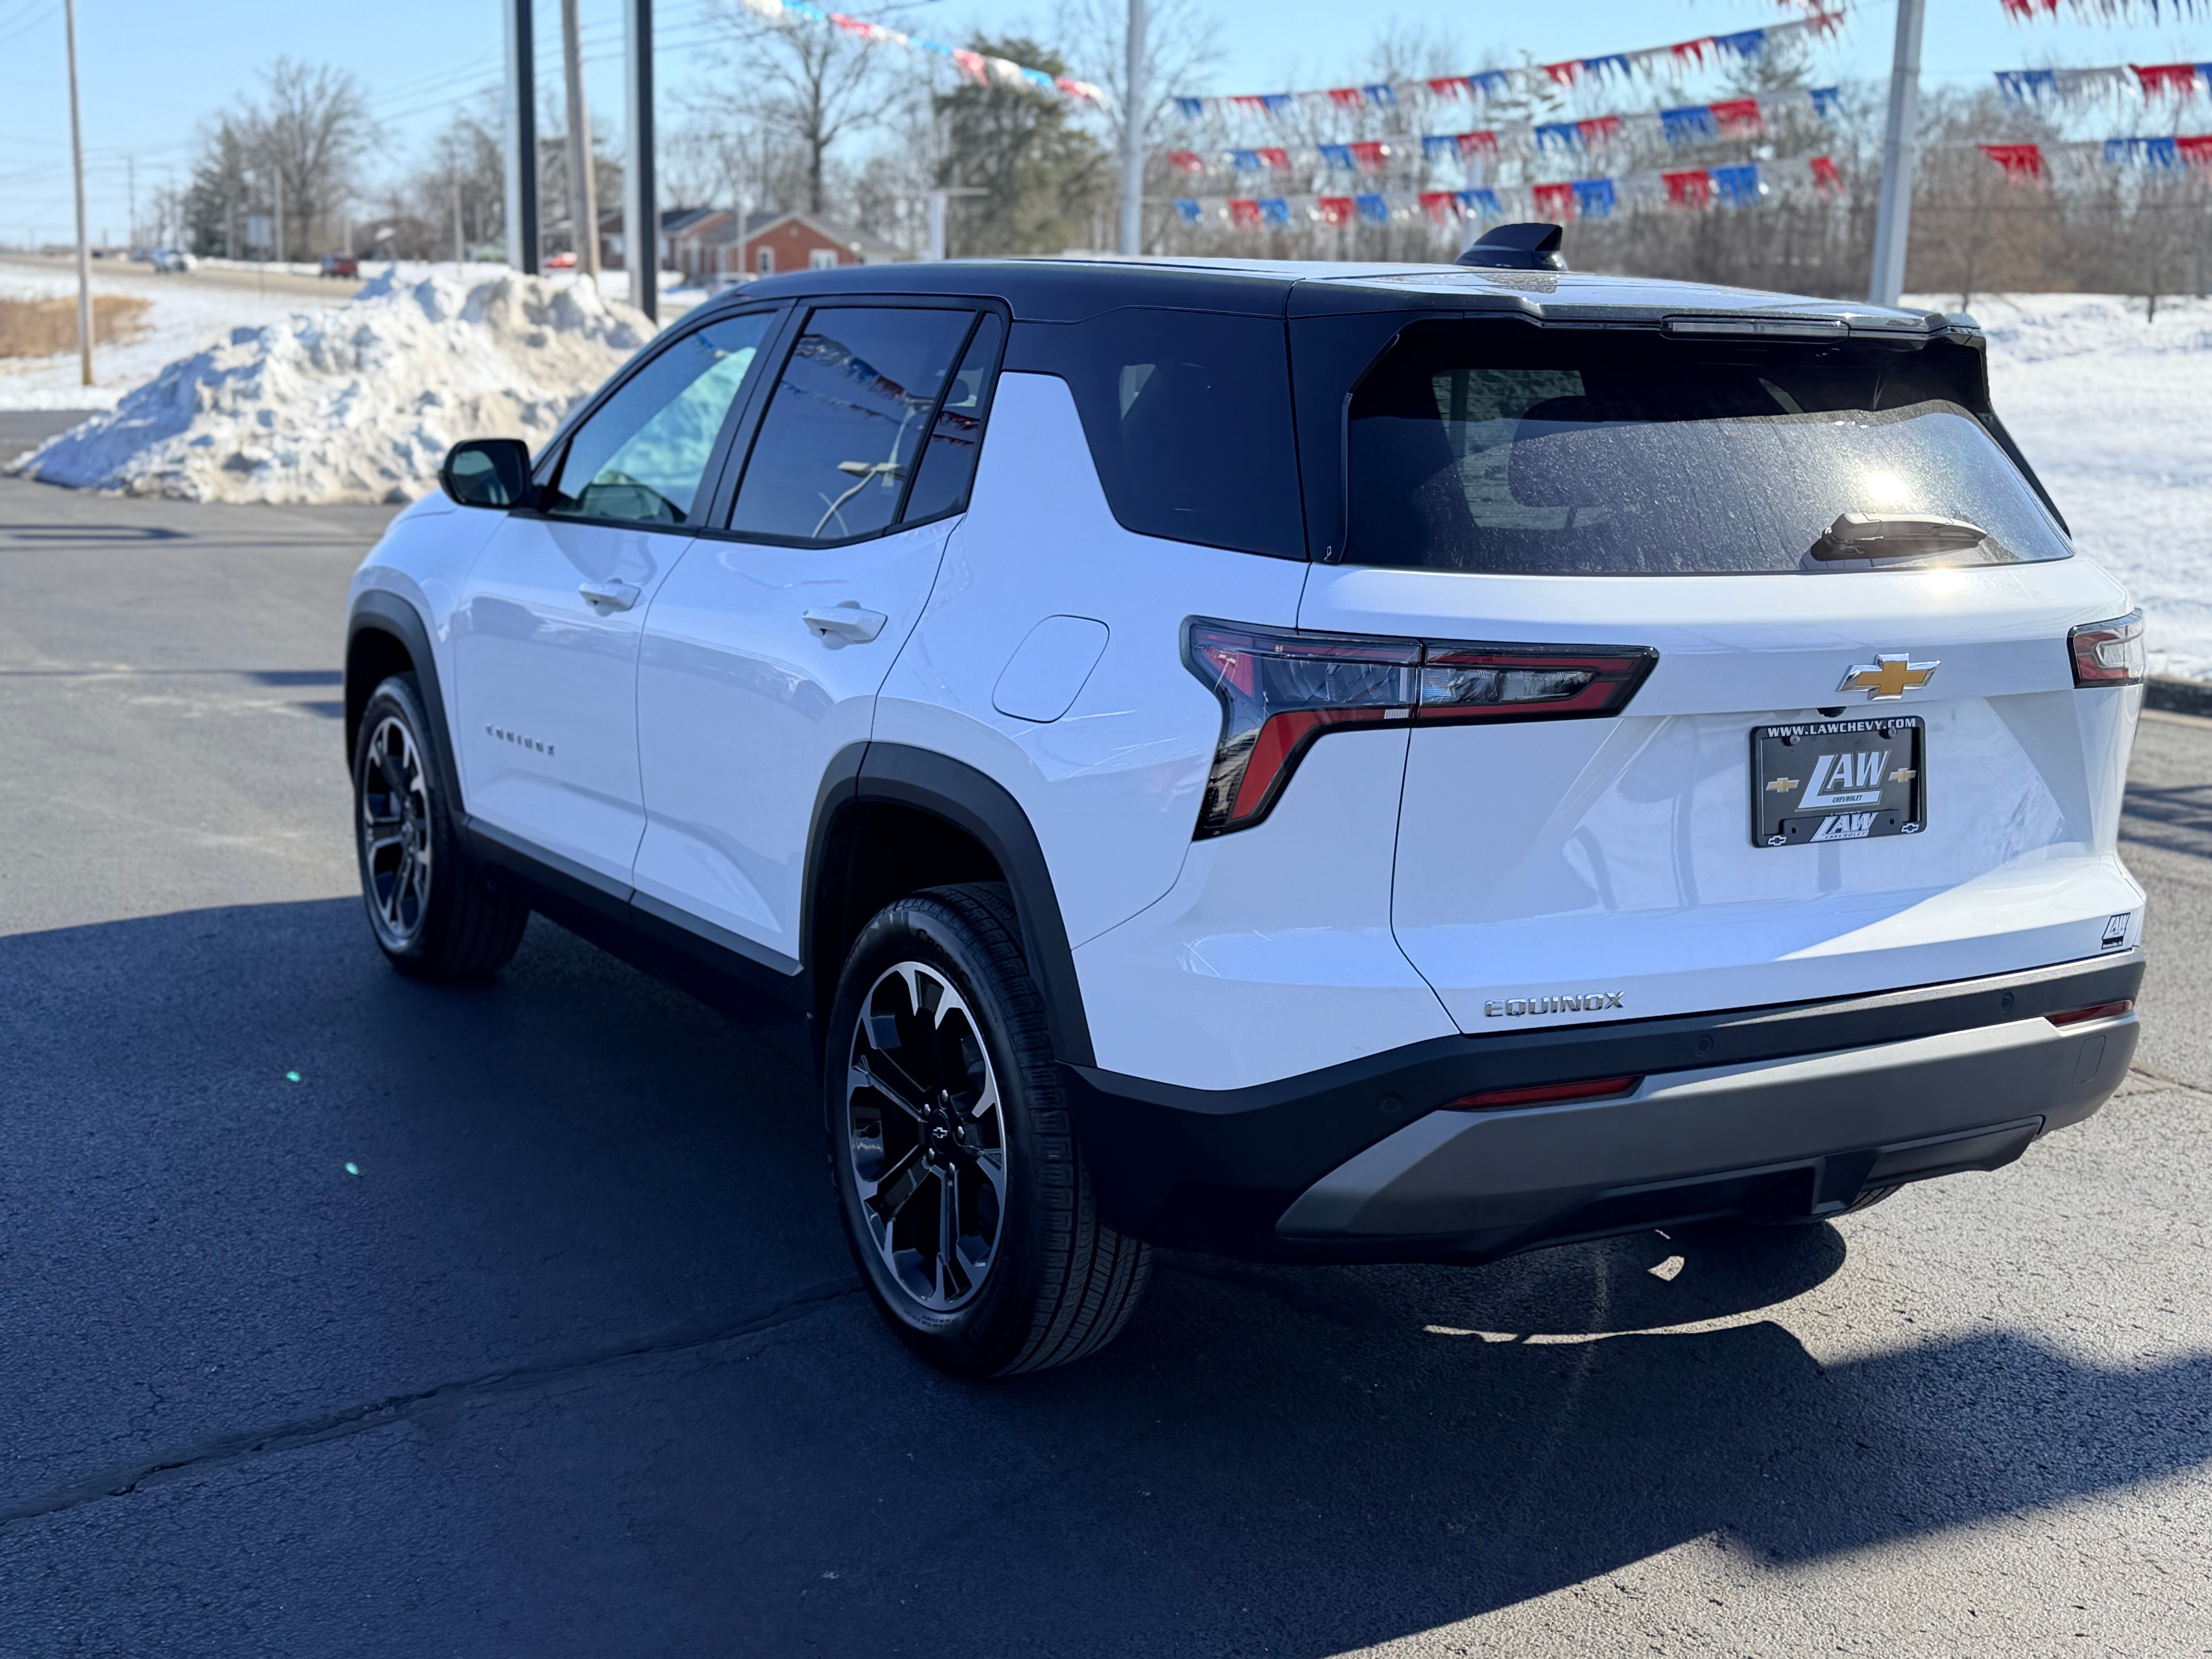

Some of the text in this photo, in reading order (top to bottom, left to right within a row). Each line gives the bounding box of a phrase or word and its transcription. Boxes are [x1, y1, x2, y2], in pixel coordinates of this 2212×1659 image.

[1767, 718, 1916, 737] WWW.LAWCHEVY.COM
[1797, 750, 1890, 810] LAW
[1810, 812, 1879, 842] LAW
[1485, 991, 1625, 1017] EQUINOX
